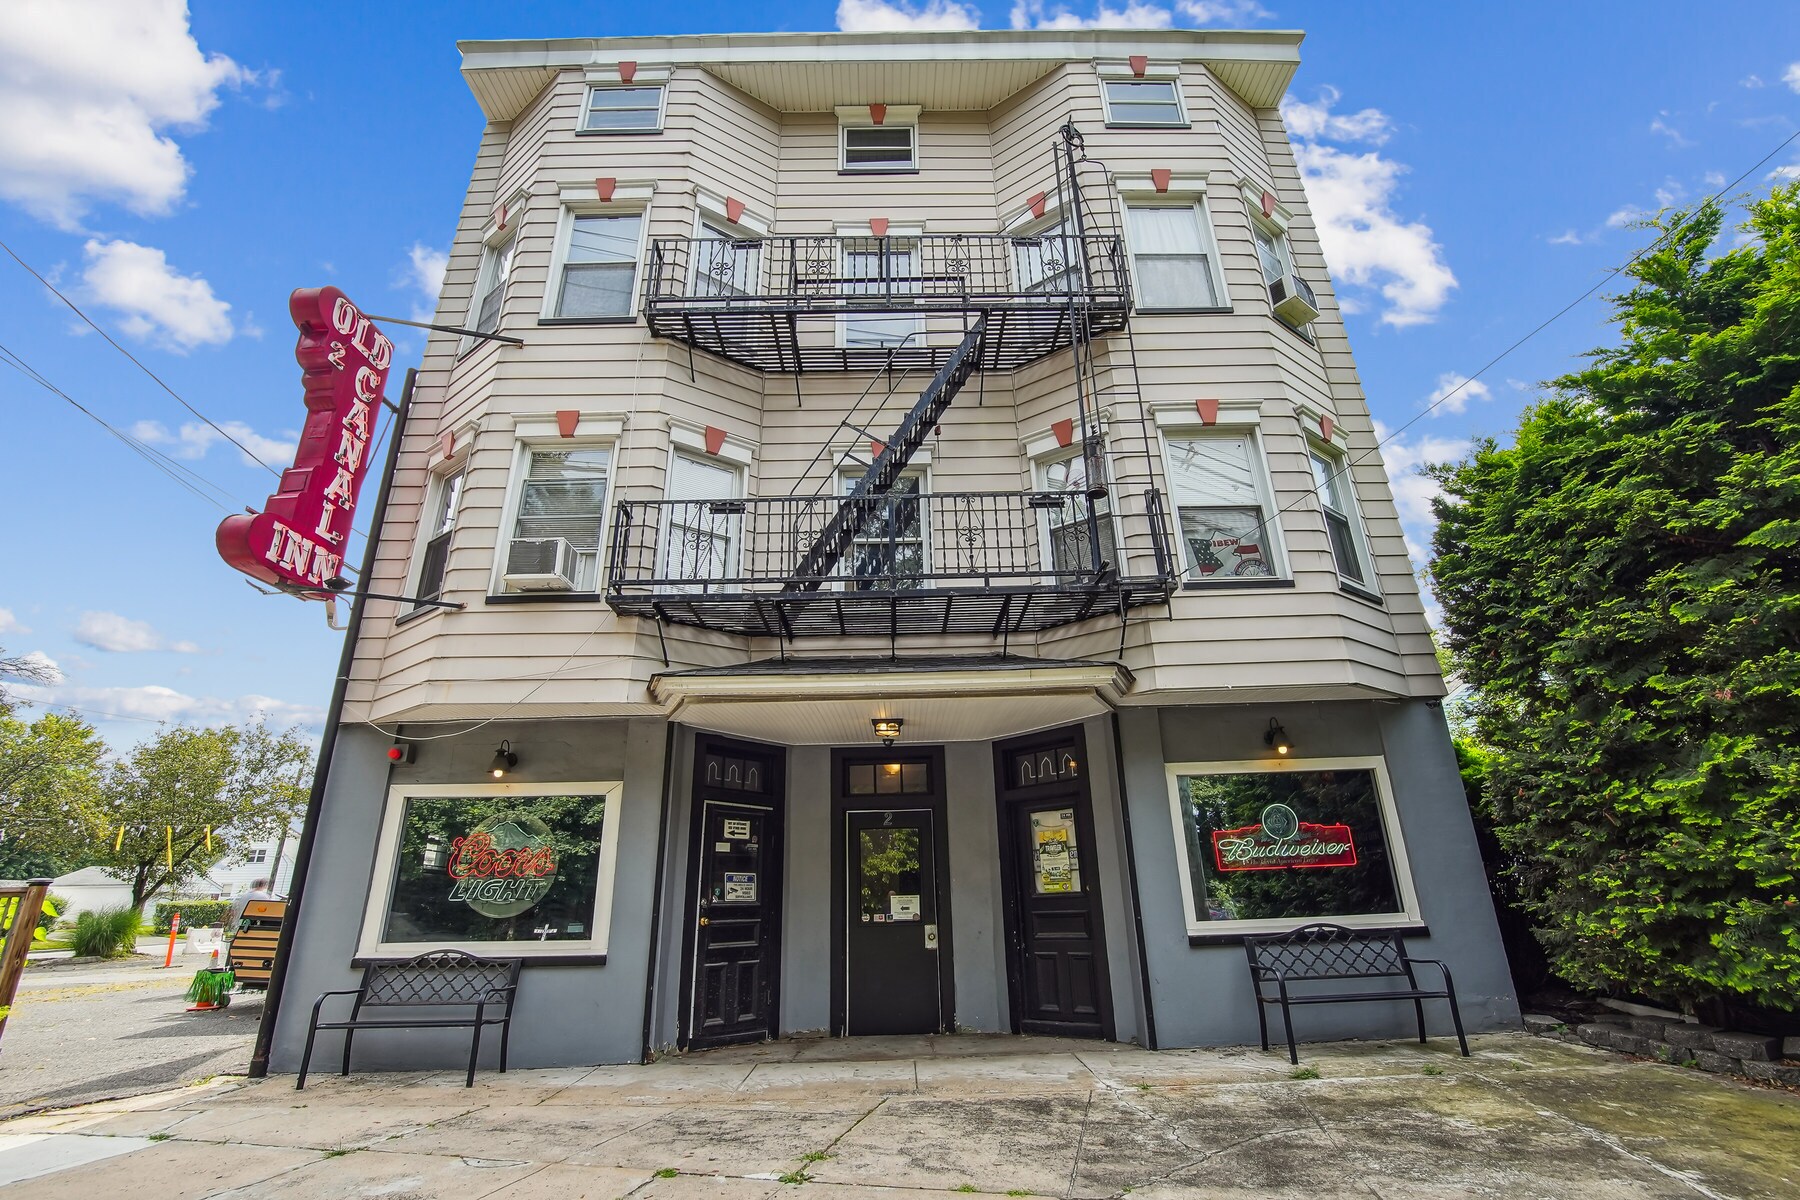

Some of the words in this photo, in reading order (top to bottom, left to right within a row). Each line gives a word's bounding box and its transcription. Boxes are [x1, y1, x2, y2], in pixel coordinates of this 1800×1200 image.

[332, 297, 391, 371] OLD
[328, 340, 348, 370] 2
[315, 366, 381, 545] CANAL
[265, 520, 341, 588] INN
[1212, 538, 1239, 548] IBEW
[883, 812, 893, 826] 2
[448, 833, 555, 879] Coors
[1218, 837, 1351, 861] Budweiser
[448, 879, 545, 902] LIGHT
